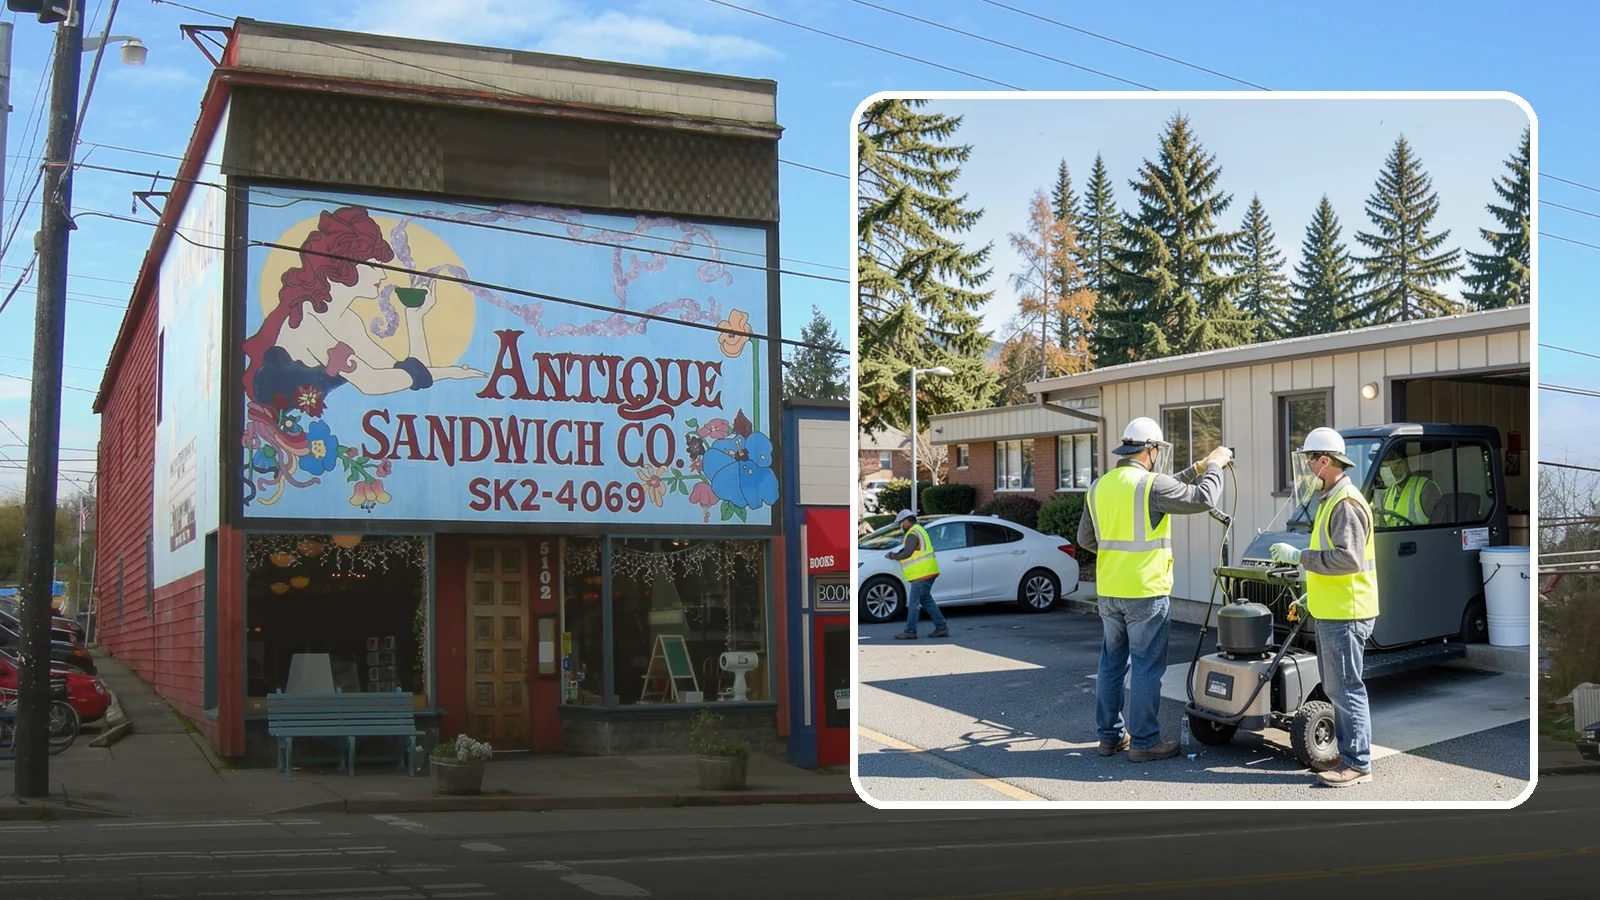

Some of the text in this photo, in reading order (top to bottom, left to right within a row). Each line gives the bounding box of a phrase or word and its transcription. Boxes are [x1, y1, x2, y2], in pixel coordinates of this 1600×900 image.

[476, 329, 723, 420] ANTIQUE
[361, 408, 685, 469] SANDWICH CO.
[468, 477, 646, 513] SK2-4069
[540, 541, 551, 600] 5102
[809, 555, 834, 569] BOOKS
